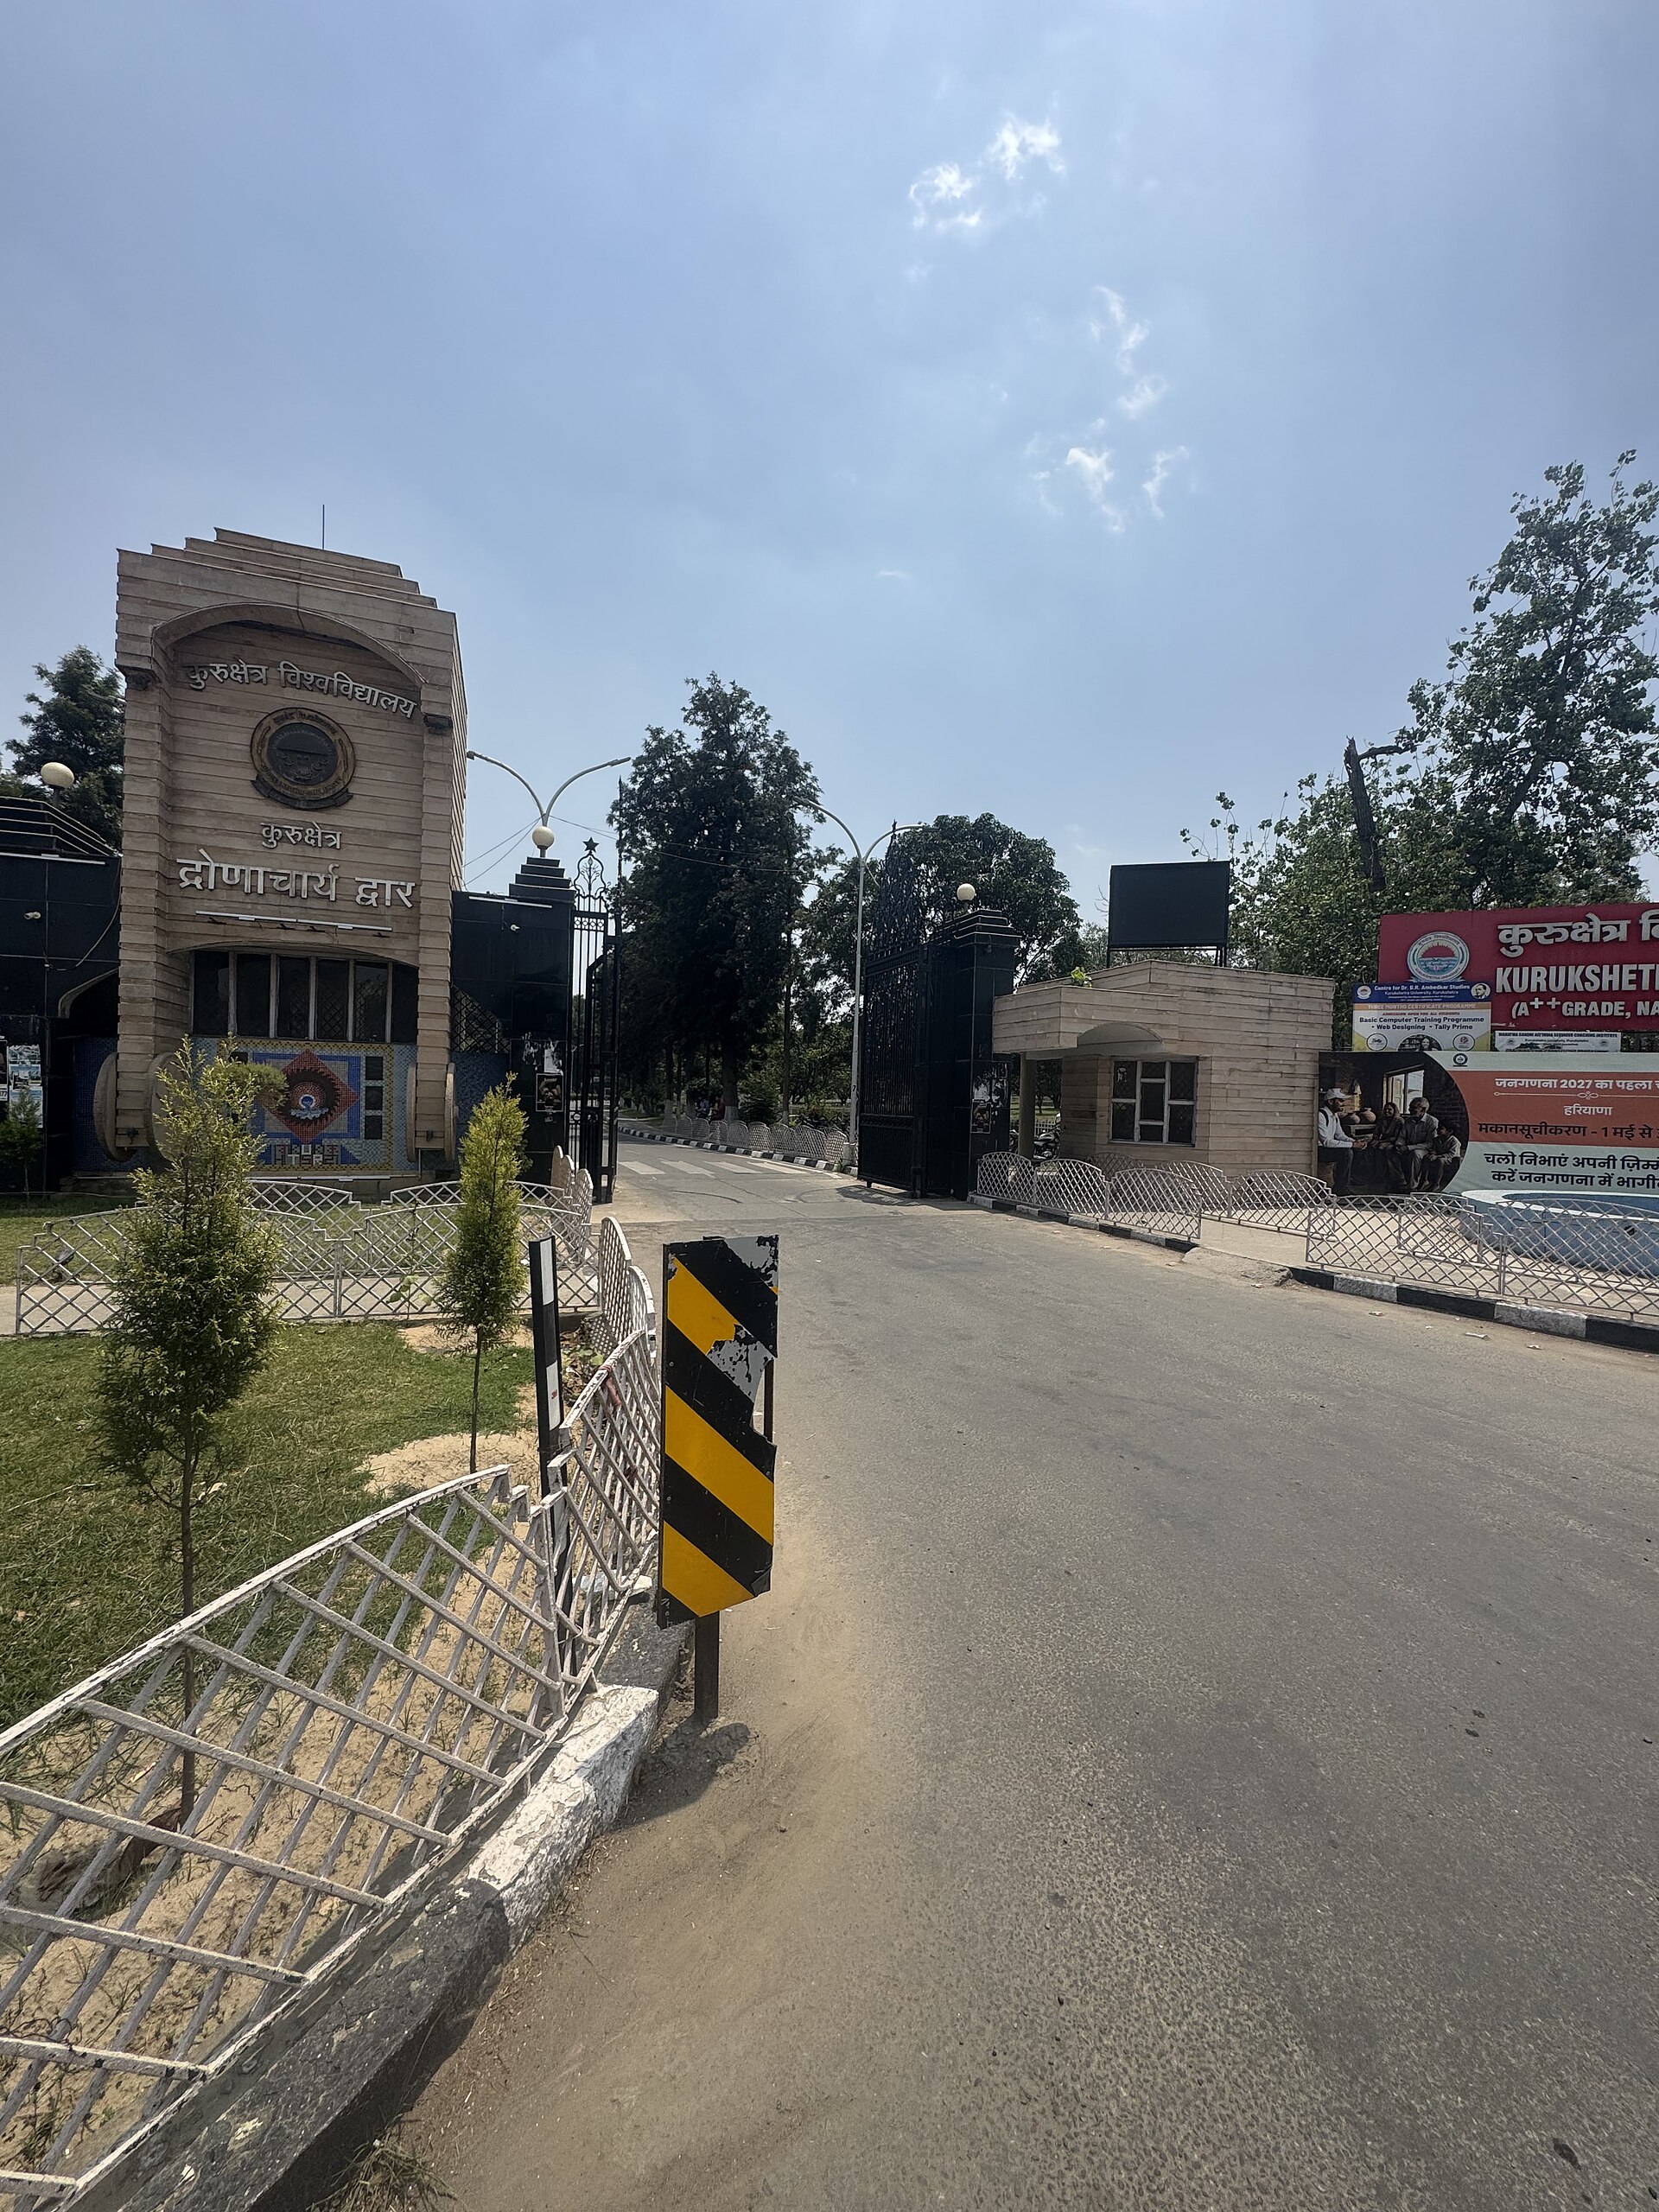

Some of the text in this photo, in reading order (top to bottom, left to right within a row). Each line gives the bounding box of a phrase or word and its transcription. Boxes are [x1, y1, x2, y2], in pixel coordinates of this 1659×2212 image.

[181, 659, 417, 719] कुरुक्षेत्र विश्वविद्यालय
[260, 821, 342, 849] कुरुक्षेत्र
[176, 849, 416, 908] द्रोणाचार्य द्वार
[1497, 912, 1631, 958] कुरुक्षेत्र
[1496, 963, 1659, 993] KURUKSHET
[1495, 1077, 1559, 1089] जनगणना
[1560, 1079, 1592, 1090] 2027
[1594, 1079, 1614, 1090] का
[1616, 1079, 1653, 1090] पहला
[1564, 1103, 1613, 1116] हरियाणा
[1478, 1122, 1587, 1139] मकानसूचीकरण
[1601, 1127, 1608, 1137] 1
[1611, 1124, 1636, 1141] मई
[1638, 1124, 1653, 1139] से
[1484, 1151, 1516, 1165] चलो
[1519, 1152, 1569, 1167] निभाएं
[1573, 1154, 1618, 1170] अपनी
[1491, 1168, 1517, 1183] करें
[1519, 1172, 1595, 1186] जनगणना
[1598, 1173, 1615, 1187] में
